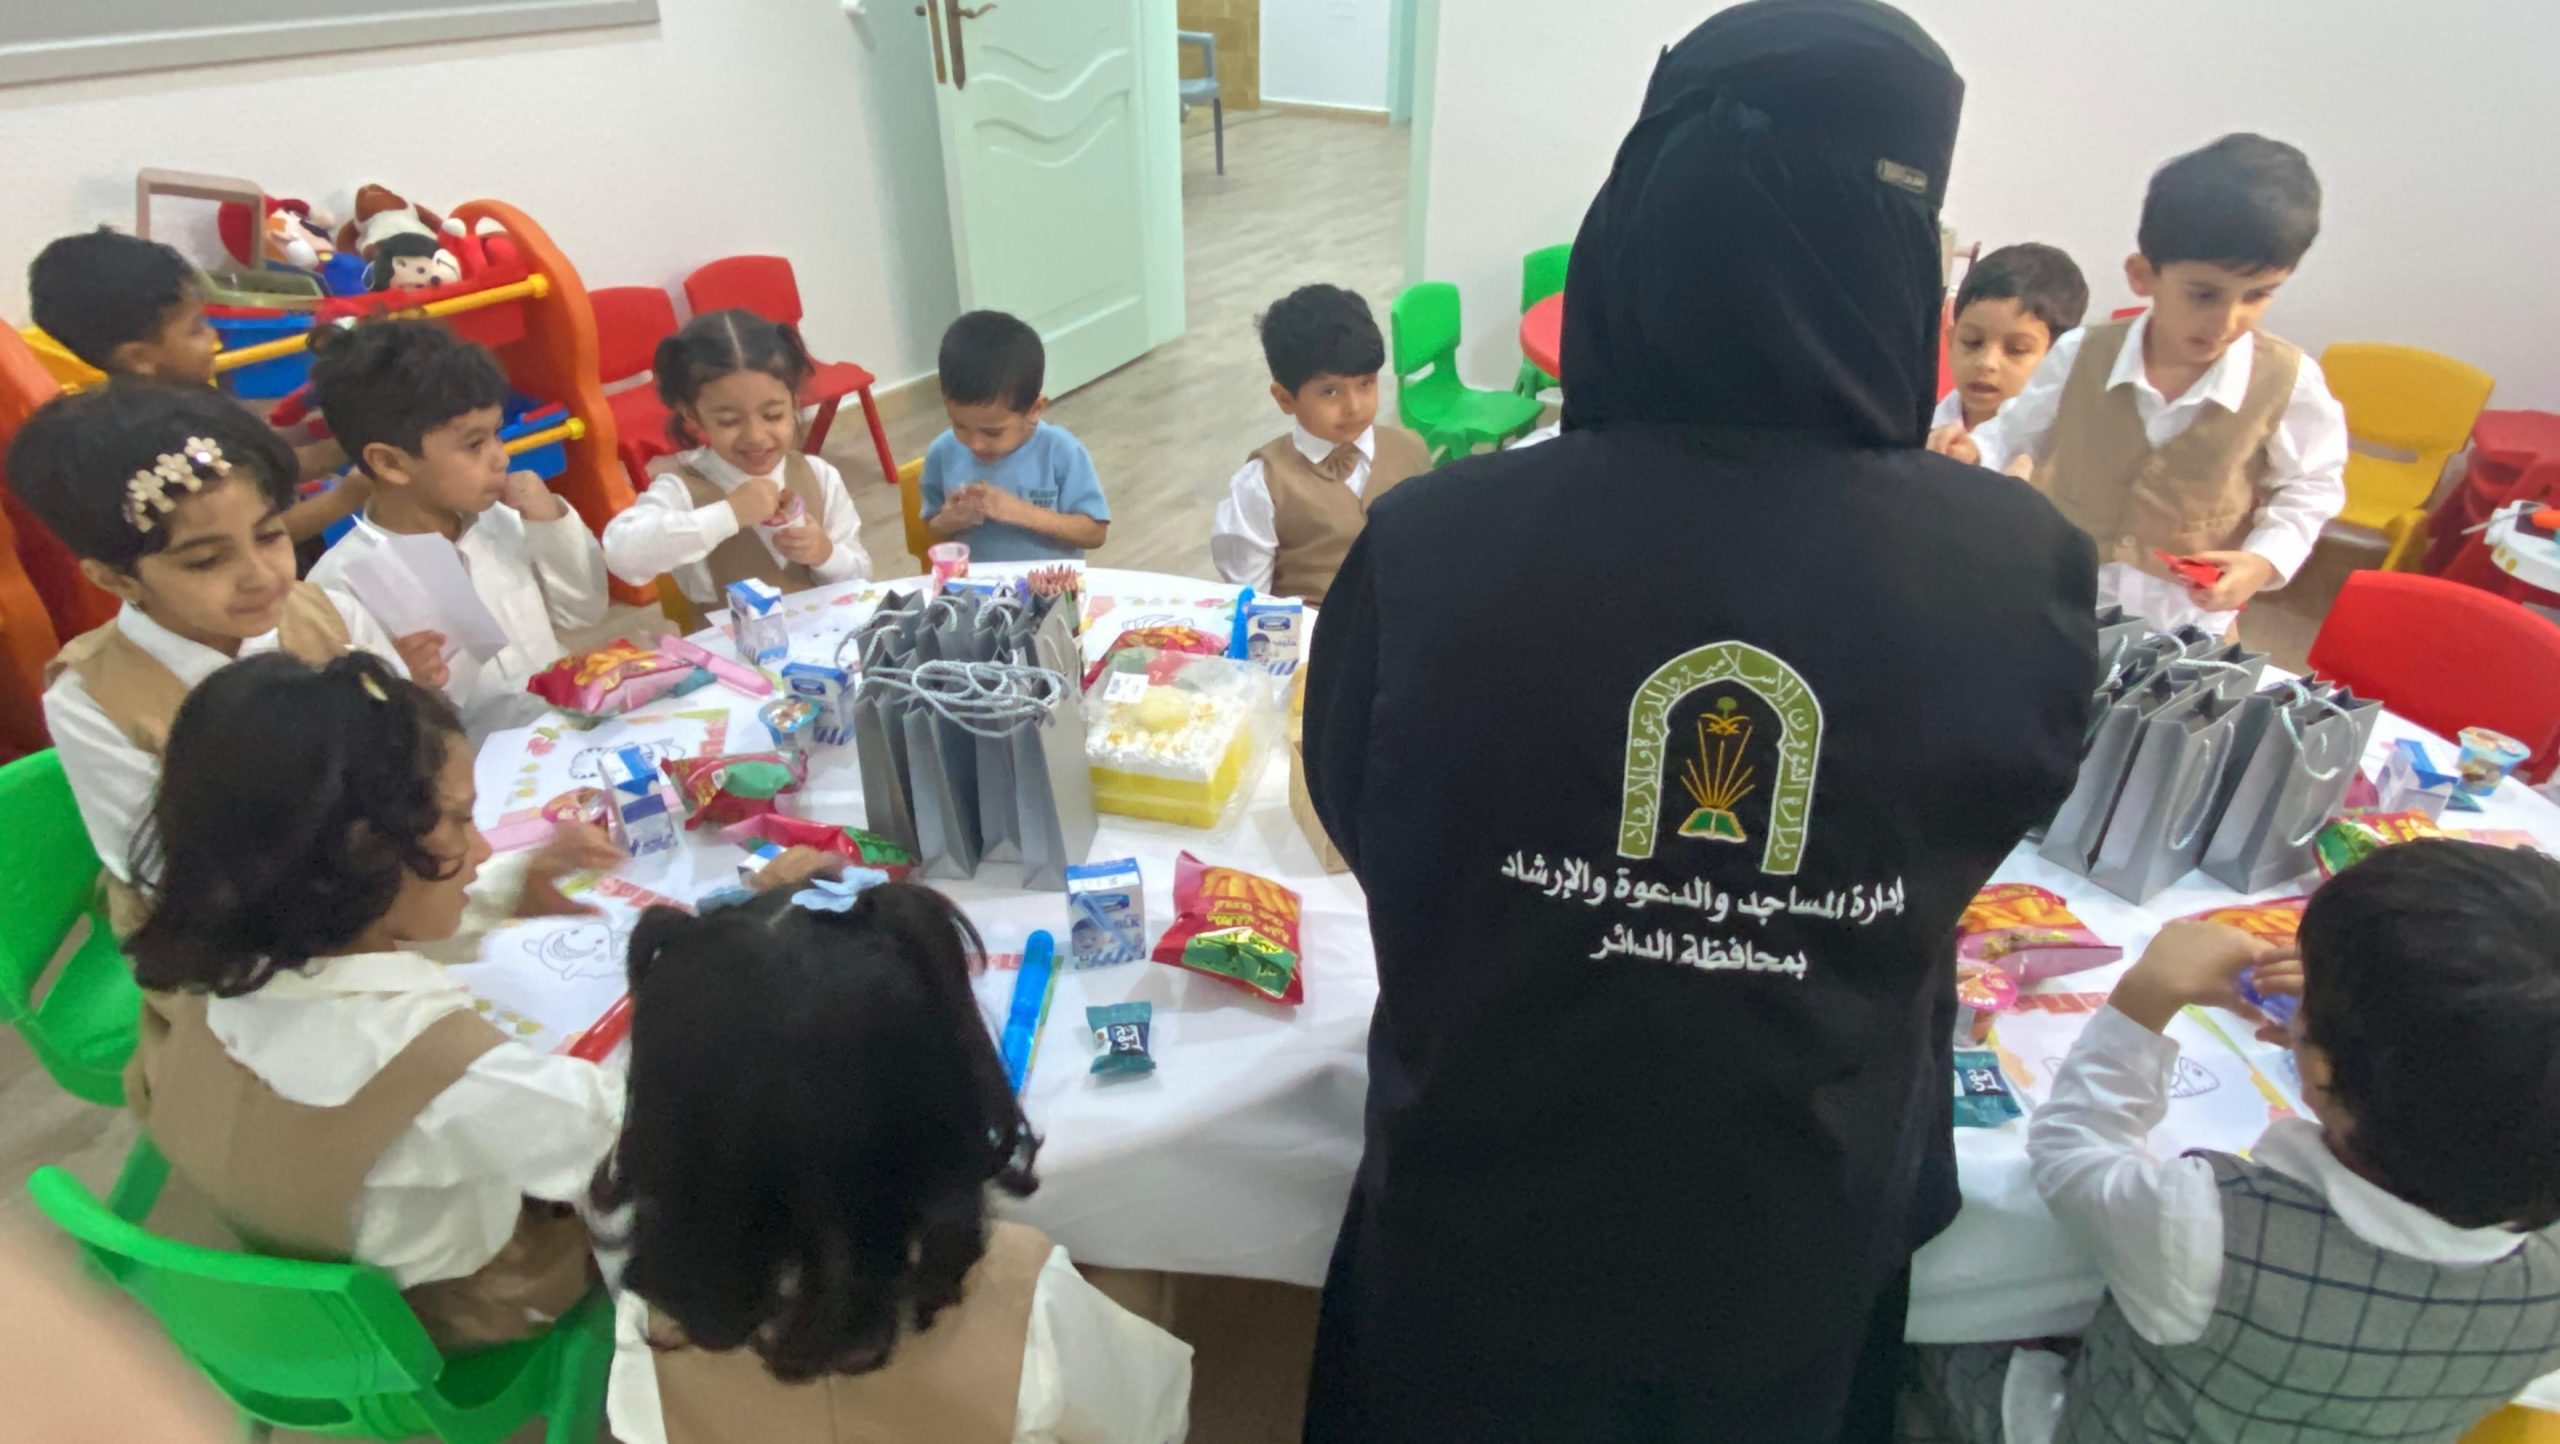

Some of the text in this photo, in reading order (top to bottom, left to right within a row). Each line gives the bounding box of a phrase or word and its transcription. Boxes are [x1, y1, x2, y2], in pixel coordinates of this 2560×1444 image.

[1500, 850, 1905, 927] إدارة المساجد والدعوة والإرشاد
[1589, 922, 1809, 981] بمحافظة الدائر
